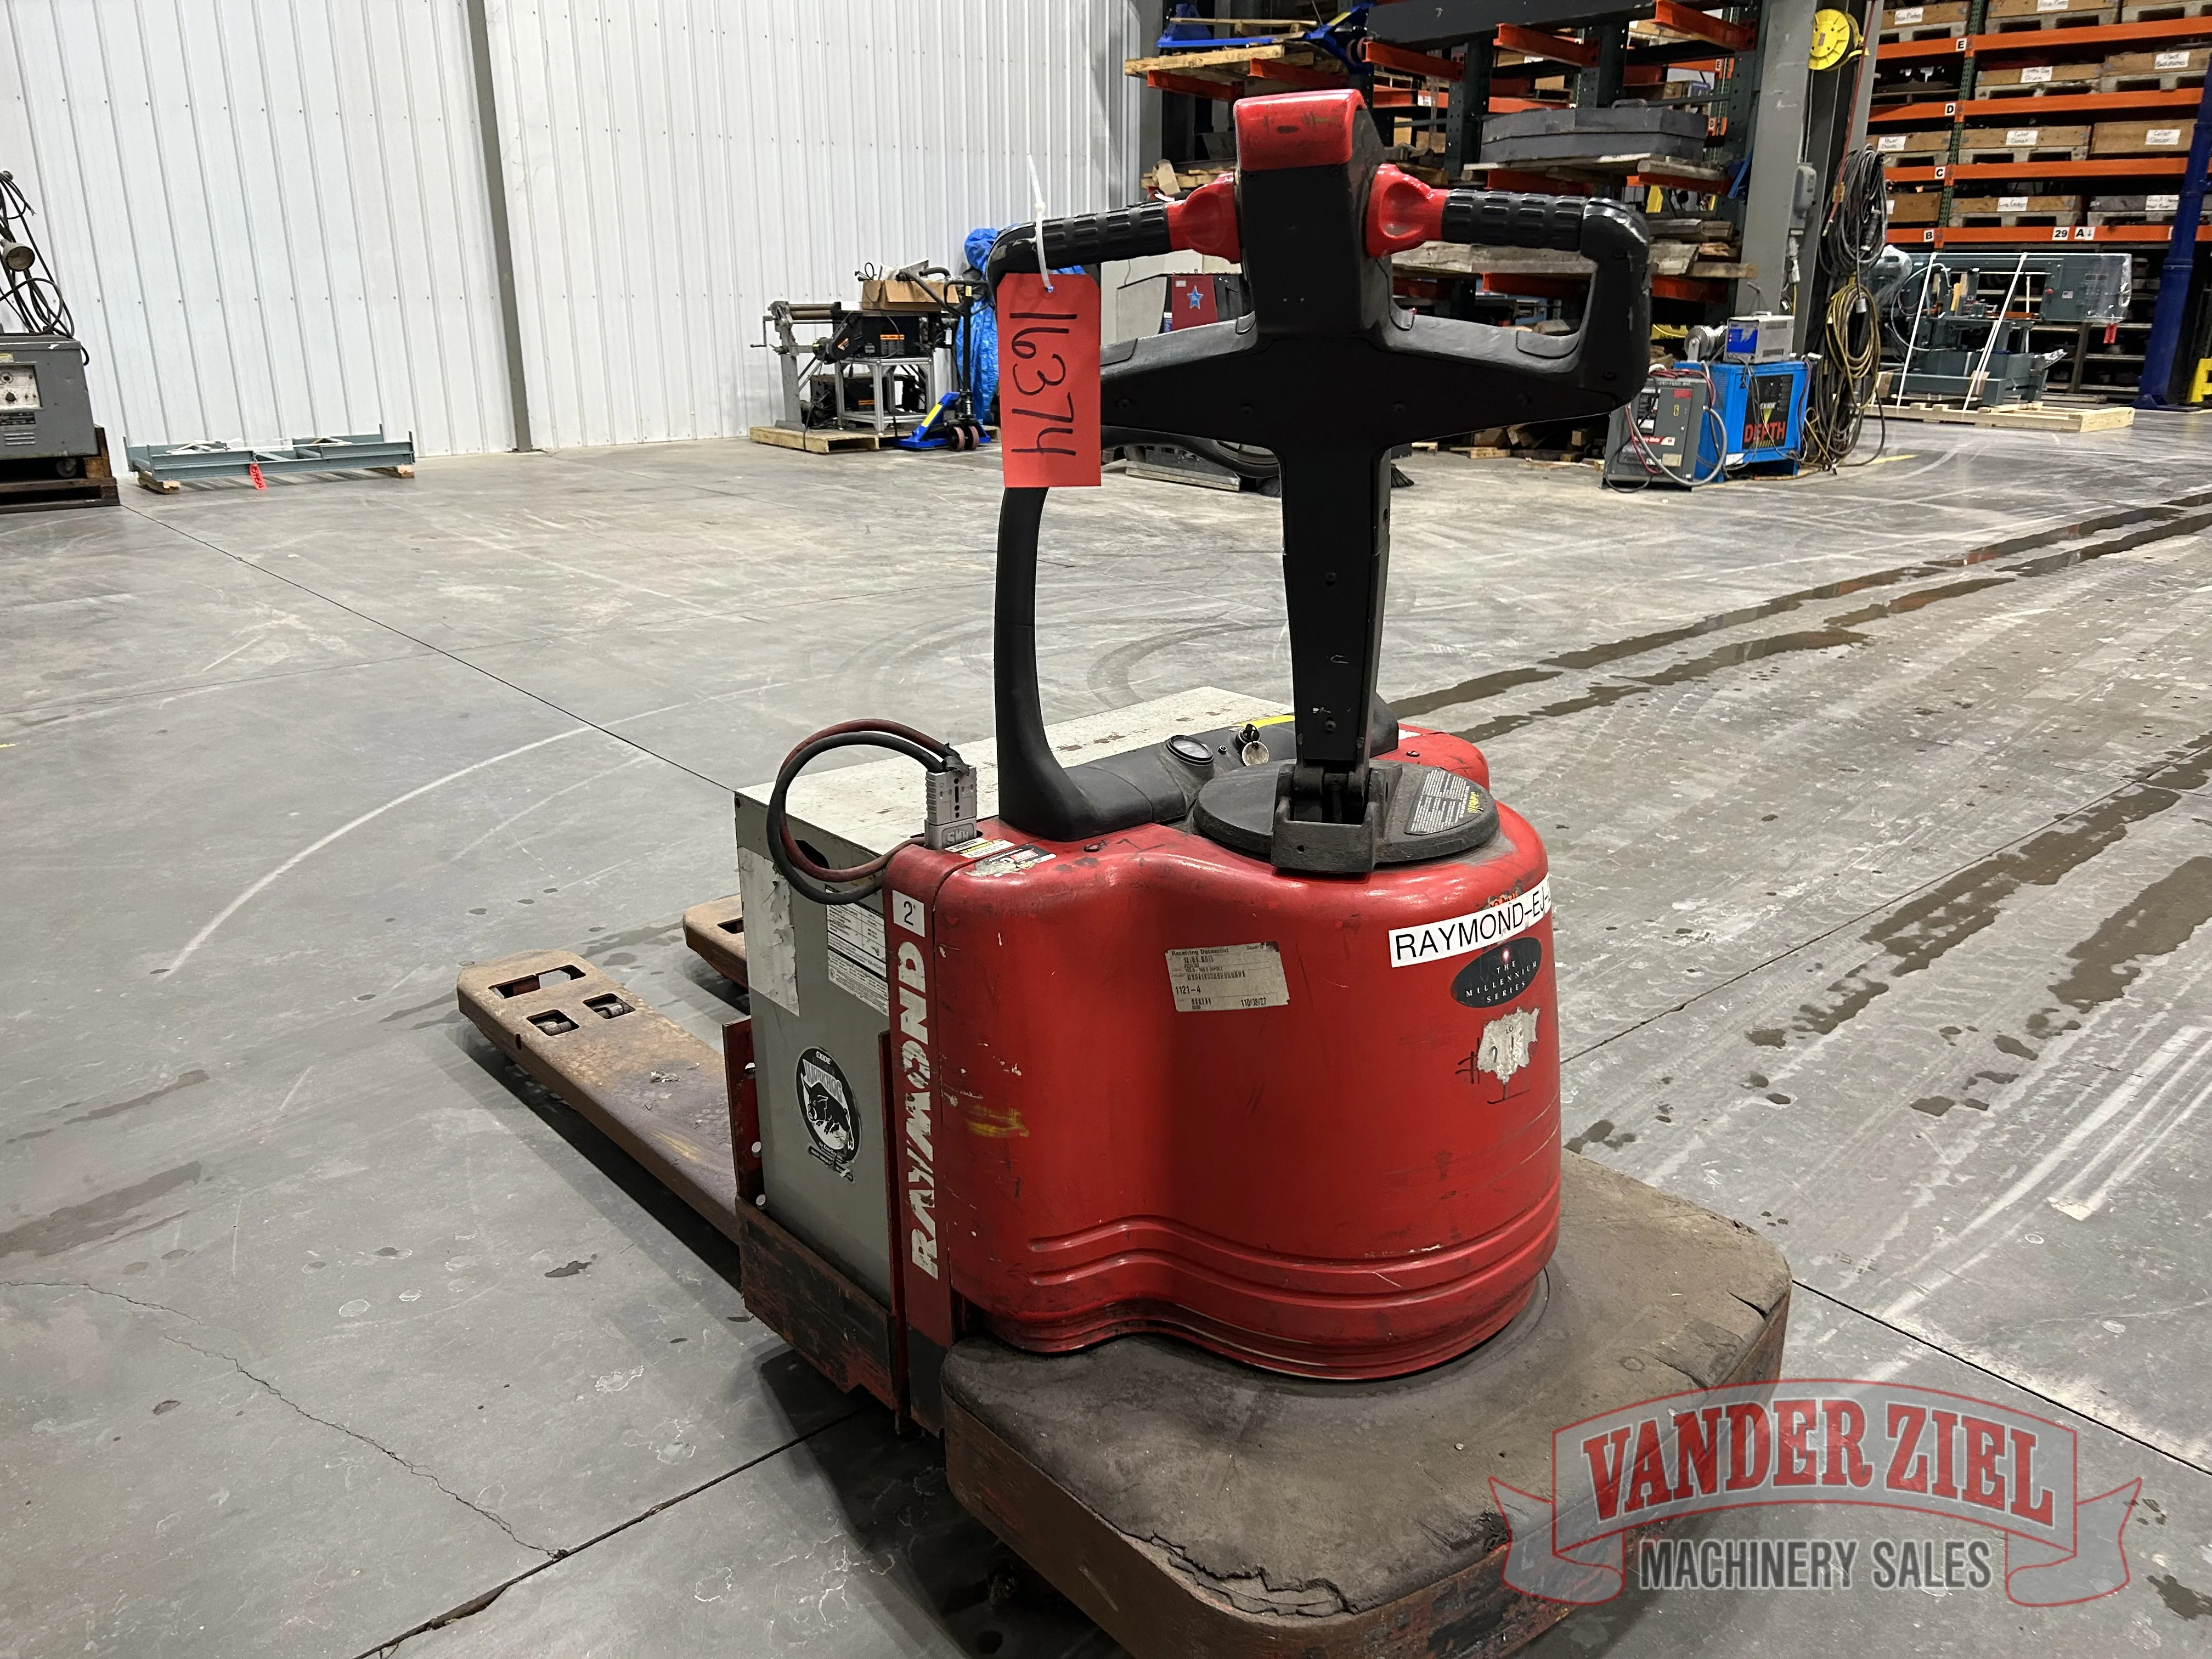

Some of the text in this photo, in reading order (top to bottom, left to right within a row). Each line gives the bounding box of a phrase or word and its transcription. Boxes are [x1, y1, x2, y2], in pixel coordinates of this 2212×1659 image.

[1958, 41, 1965, 49] E
[1947, 105, 1954, 114] D
[1936, 169, 1943, 177] C
[1925, 231, 1933, 240] B
[2055, 228, 2084, 238] 29 A
[1009, 313, 1078, 456] 16374
[904, 900, 914, 927] 2
[1496, 960, 1516, 974] THE
[1465, 961, 1537, 997] MILLENNIUM
[1175, 984, 1201, 995] 1121-4
[1486, 980, 1526, 1003] SERIES
[815, 1051, 832, 1065] EXIDE
[897, 940, 939, 1280] RAYMOND
